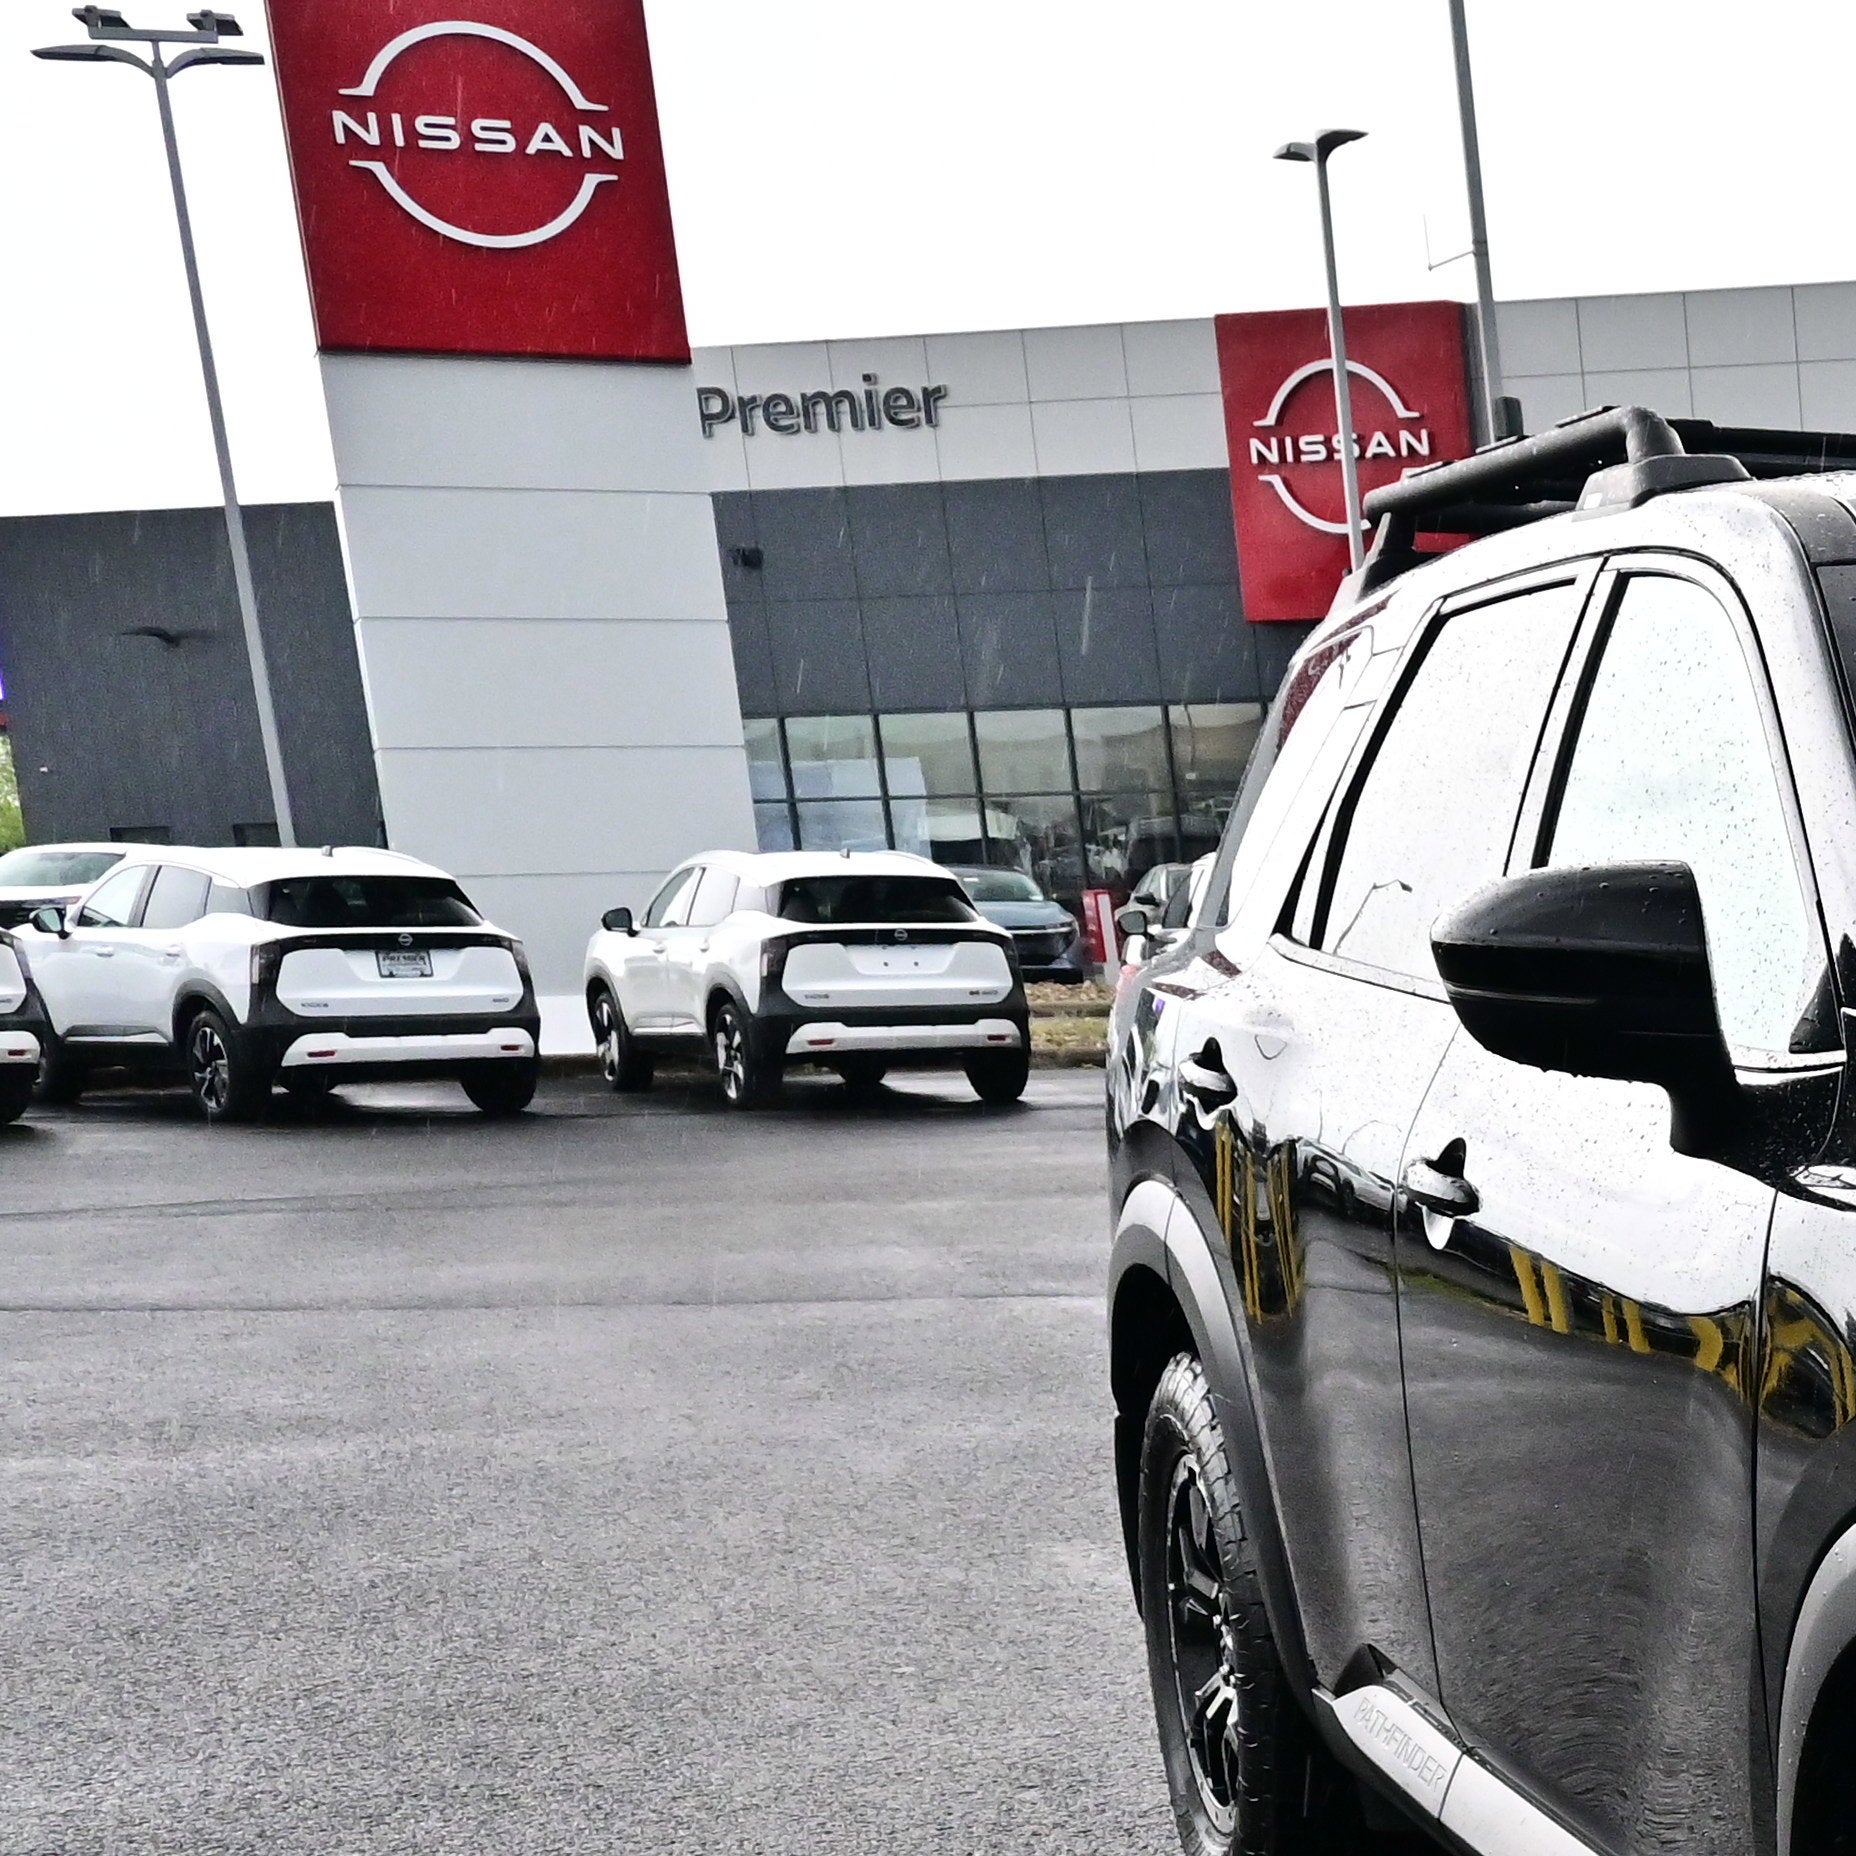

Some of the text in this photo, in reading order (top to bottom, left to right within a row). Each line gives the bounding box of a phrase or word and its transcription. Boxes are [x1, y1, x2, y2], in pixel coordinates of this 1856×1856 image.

[332, 110, 624, 160] NISSAN
[697, 373, 947, 438] Premier
[1353, 1697, 1448, 1792] PATHFINDER
